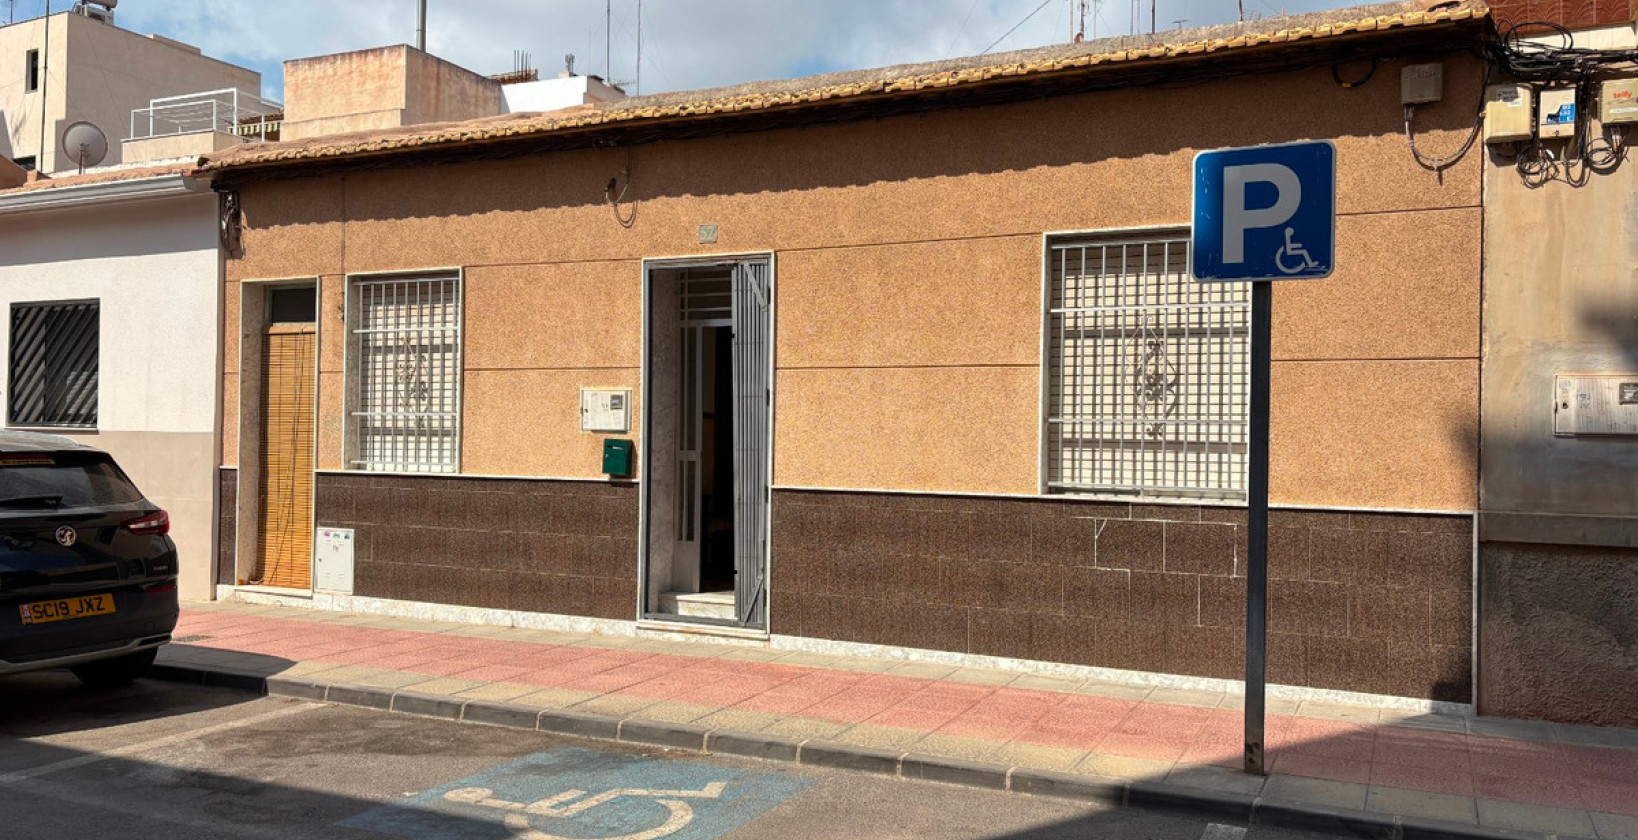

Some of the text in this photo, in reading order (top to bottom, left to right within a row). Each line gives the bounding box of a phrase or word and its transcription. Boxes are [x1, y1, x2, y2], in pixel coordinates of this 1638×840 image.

[1223, 163, 1301, 264] P
[32, 601, 70, 619] SC19
[75, 597, 106, 613] JXZ
